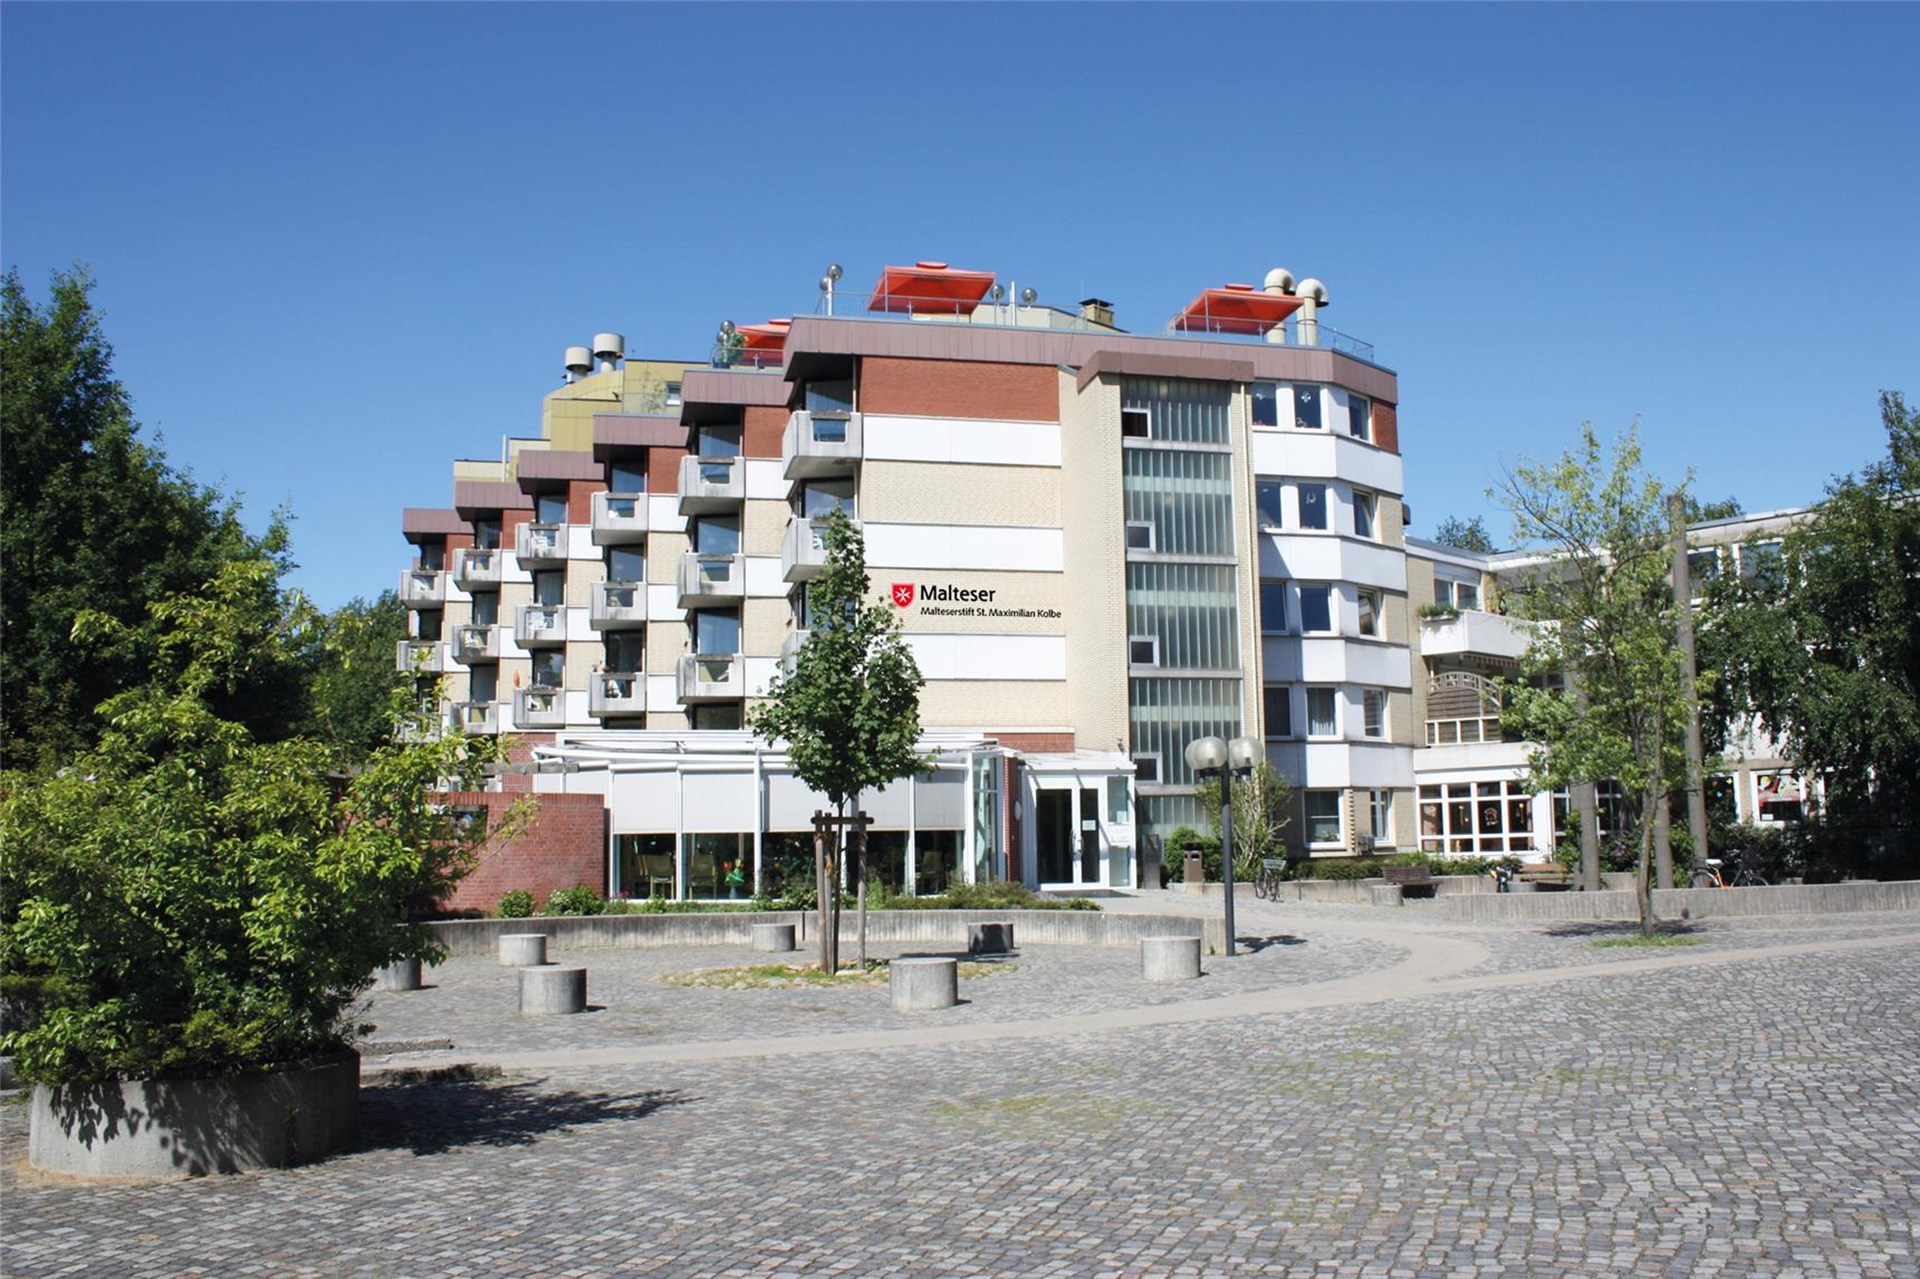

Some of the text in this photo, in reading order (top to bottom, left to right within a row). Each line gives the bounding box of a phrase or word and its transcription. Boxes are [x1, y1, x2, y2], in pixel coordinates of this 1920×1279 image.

[920, 584, 996, 602] Malteser
[920, 606, 1062, 619] Malteserstift St. Maximilian Kolbe
